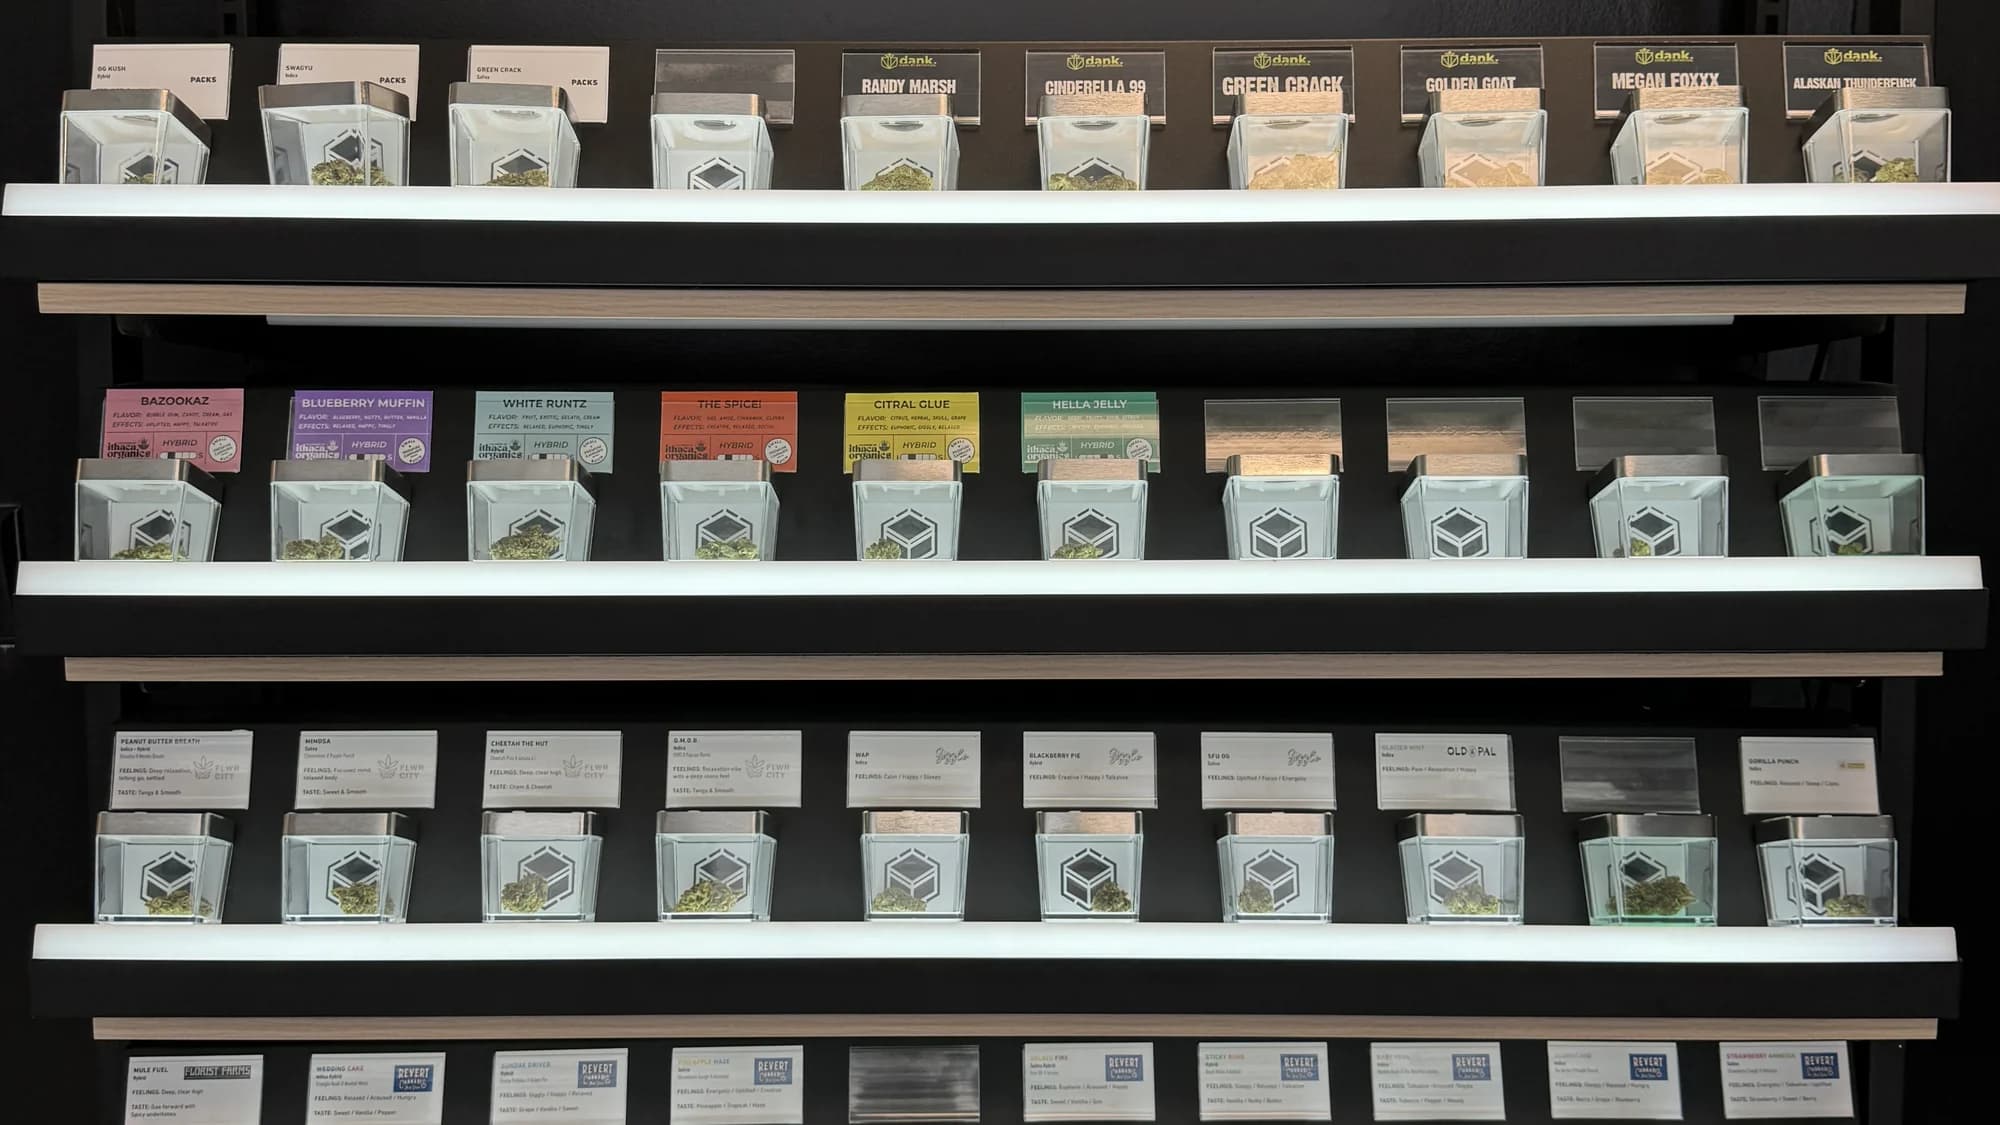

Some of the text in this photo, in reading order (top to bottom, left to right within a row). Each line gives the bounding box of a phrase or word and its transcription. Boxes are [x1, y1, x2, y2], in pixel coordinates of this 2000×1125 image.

[1222, 76, 1343, 95] GREEN CRACK
[1426, 77, 1516, 92] GOLDEN GOAT
[1612, 72, 1719, 89] MEGAN FOXXX
[1794, 78, 1917, 89] ALASKAN THUNDERFUCK
[862, 79, 956, 94] RANDY MARSH
[1045, 80, 1146, 95] CINDERELLA 99
[141, 396, 209, 406] BAZOOKAZ
[302, 399, 425, 408] BLUEBERRY MUFFIN
[503, 400, 587, 408] WHITE RUNTZ
[698, 400, 762, 408] THE SPICE!
[874, 400, 950, 409] CITRAL GLUE
[1053, 400, 1127, 408] HELLA JELLY
[163, 439, 198, 447] HYBRID
[534, 441, 569, 449] HYBRID
[1447, 746, 1496, 756] OLD PAL
[1109, 1057, 1138, 1068] REVERT
[1284, 1057, 1314, 1068] REVERT
[1455, 1057, 1486, 1068] REVERT
[1633, 1057, 1663, 1067] REVERT
[1804, 1056, 1834, 1066] REVERT
[582, 1064, 613, 1074] REVERT
[758, 1061, 789, 1072] REVERT
[398, 1067, 429, 1078] REVERT
